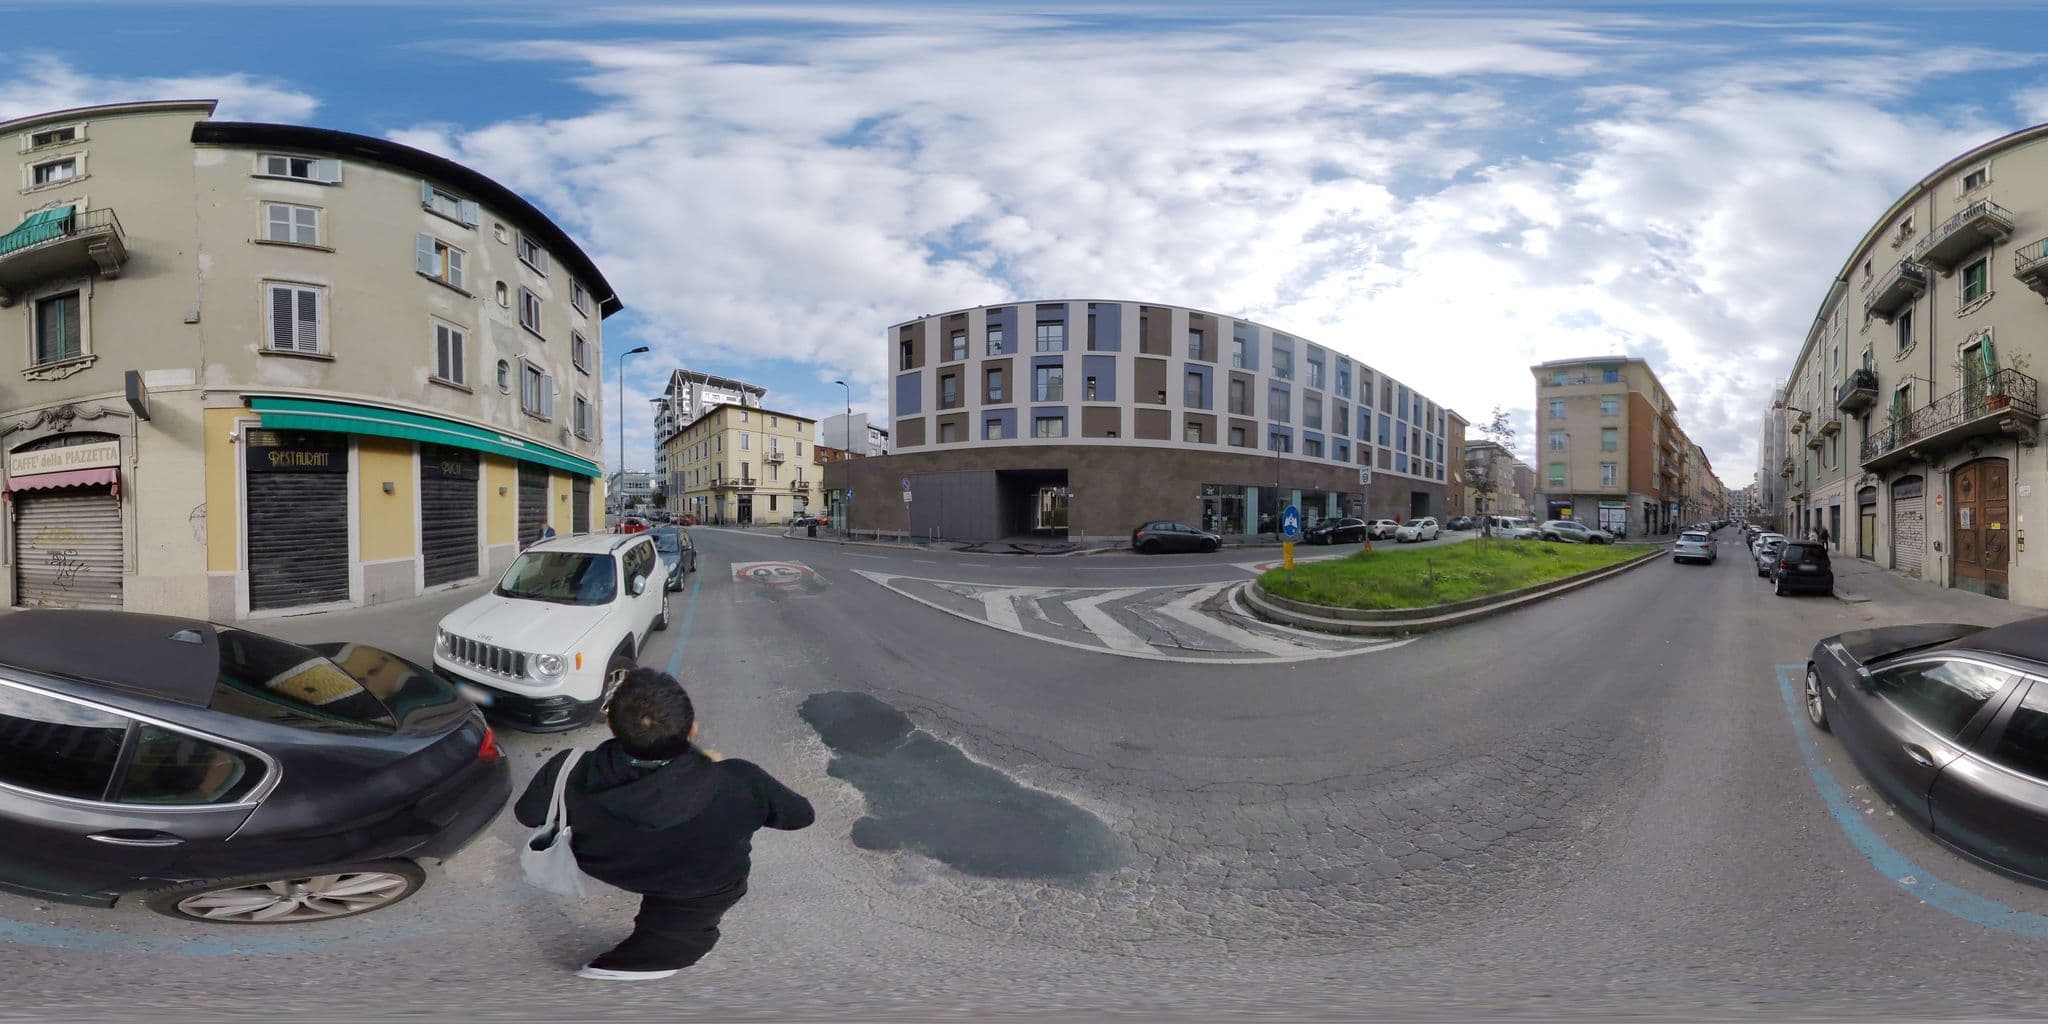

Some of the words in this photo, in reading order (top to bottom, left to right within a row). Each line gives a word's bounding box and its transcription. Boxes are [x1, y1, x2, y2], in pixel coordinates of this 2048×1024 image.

[41, 452, 62, 467] della
[65, 446, 117, 464] PIAZZETTA
[267, 451, 329, 466] RESTAURANT
